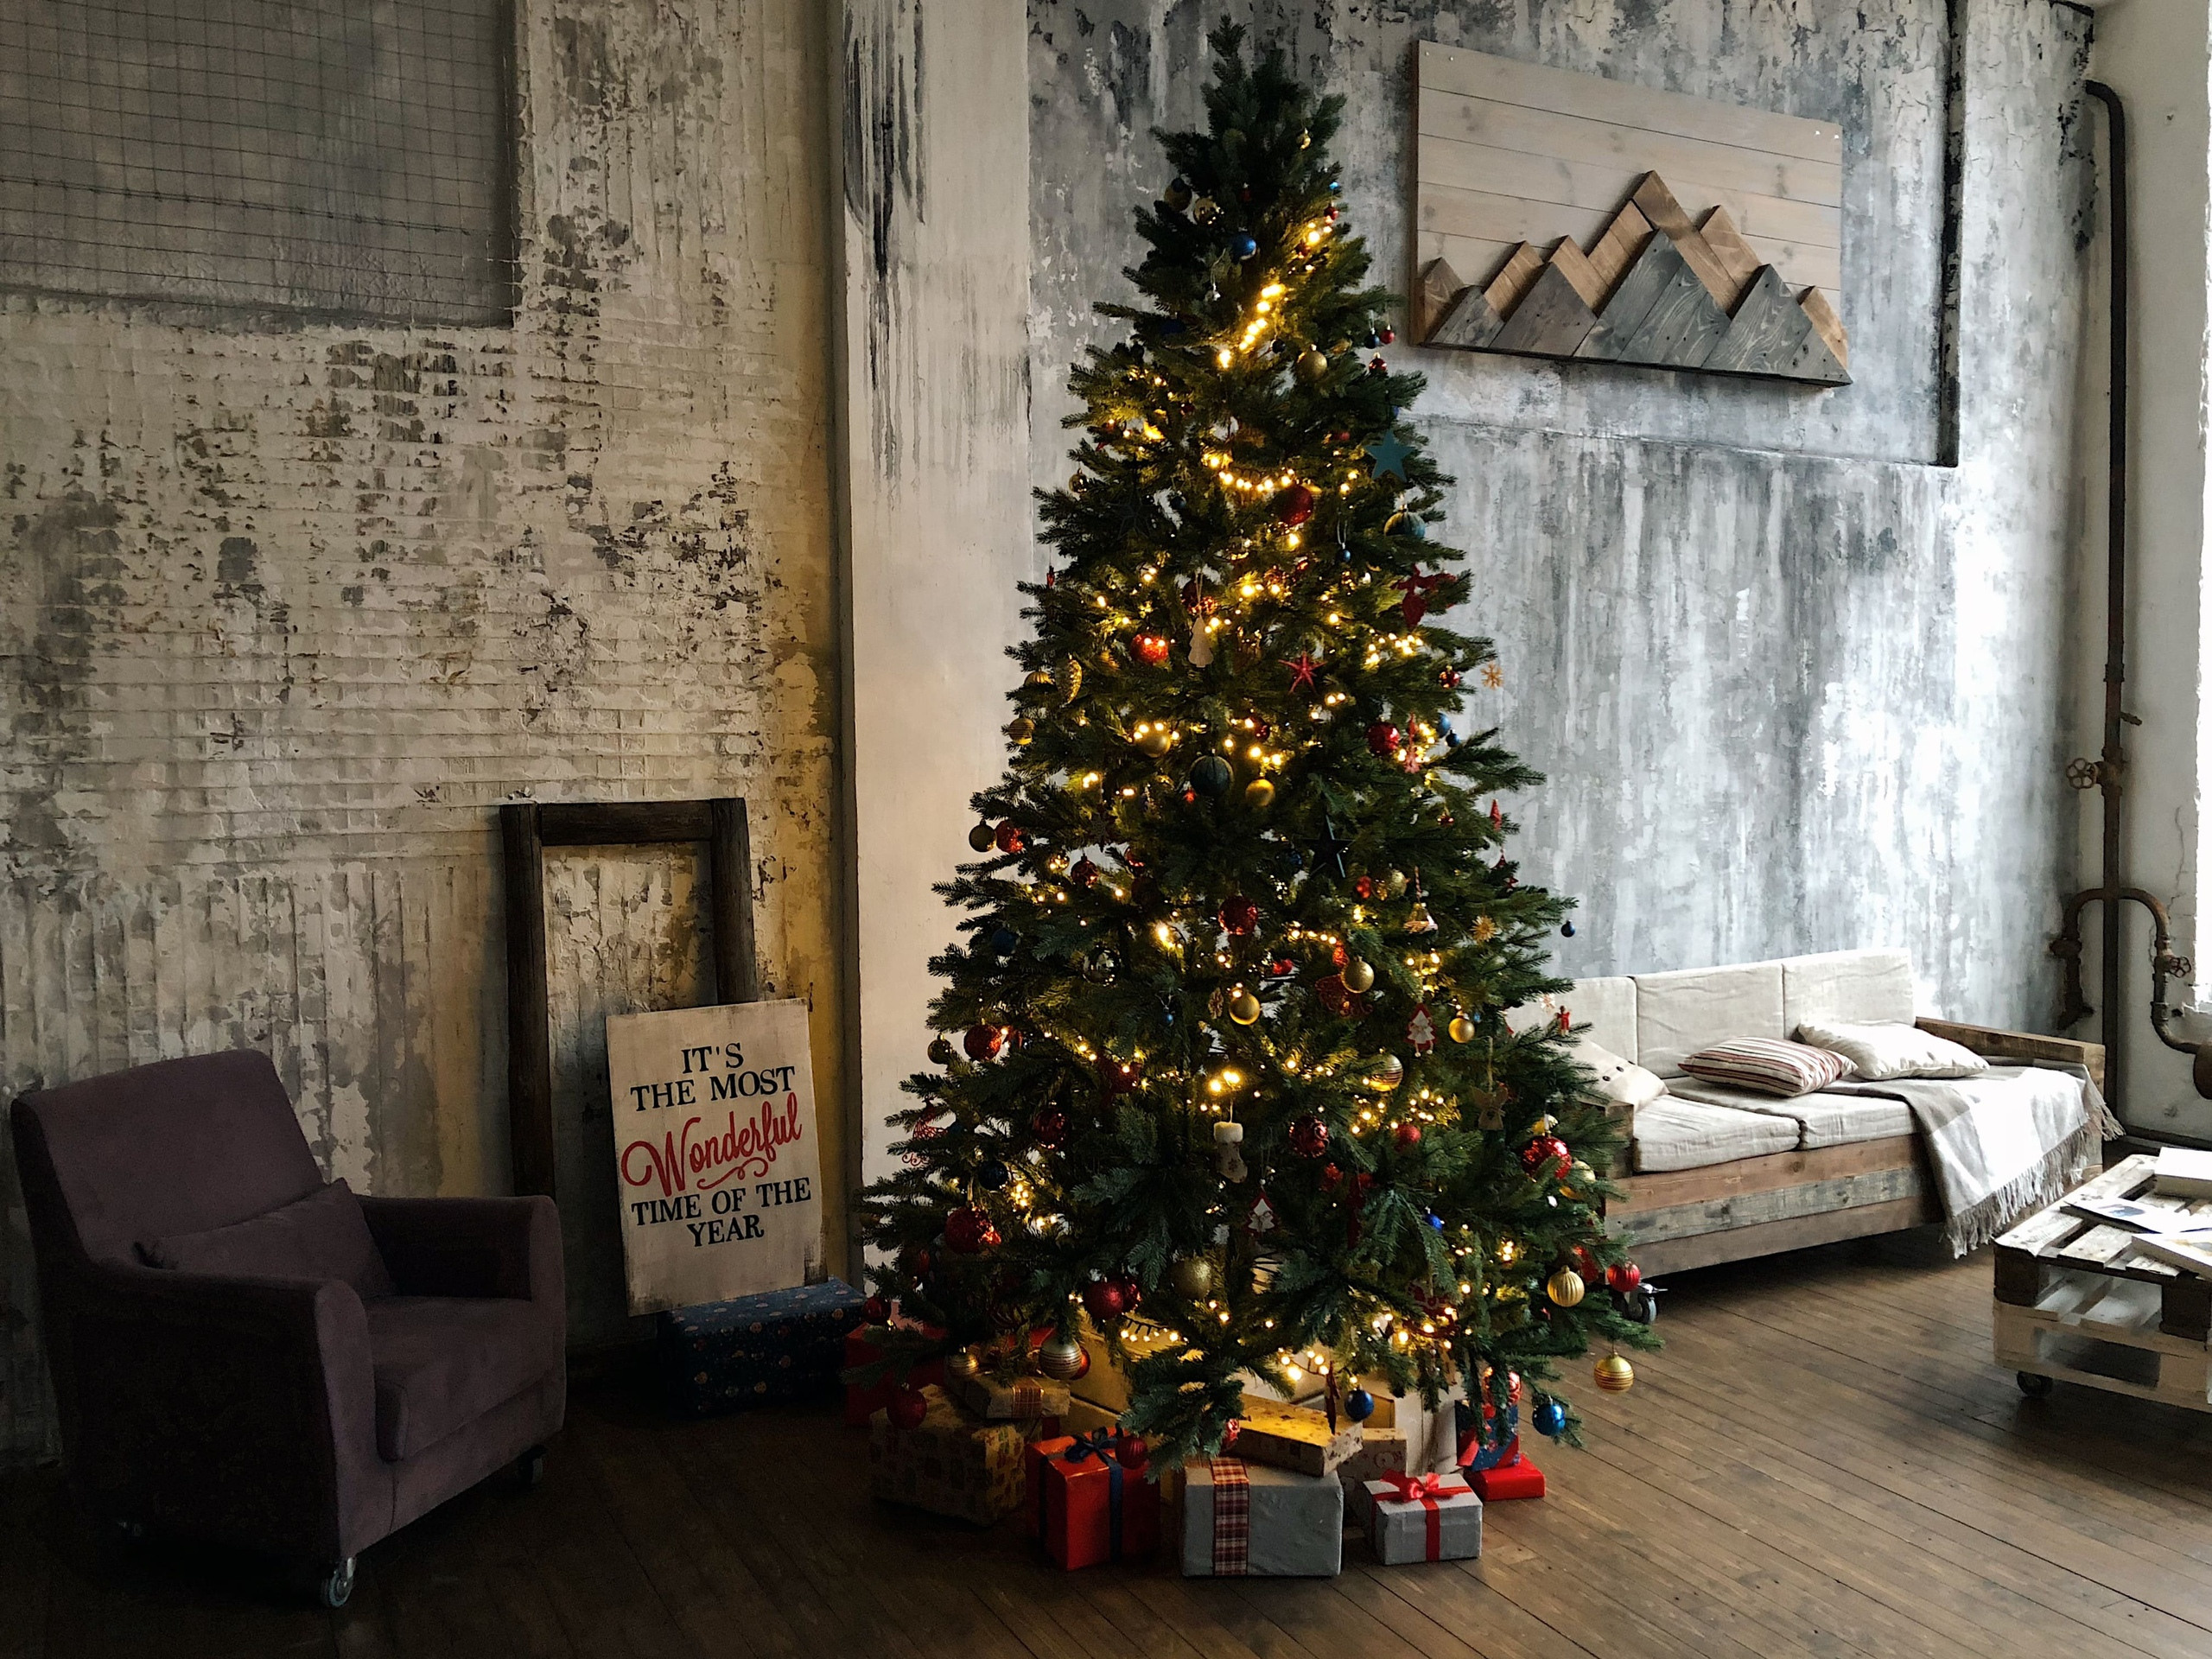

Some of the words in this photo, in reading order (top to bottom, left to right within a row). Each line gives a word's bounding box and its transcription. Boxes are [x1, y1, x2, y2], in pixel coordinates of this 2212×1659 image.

[681, 1042, 744, 1074] IT'S
[630, 1079, 696, 1112] THE
[709, 1065, 795, 1101] MOST
[620, 1092, 802, 1197] Wonderful
[631, 1194, 702, 1226] TIME
[711, 1188, 746, 1215] OF
[756, 1177, 810, 1207] THE
[686, 1215, 764, 1247] YEAR
